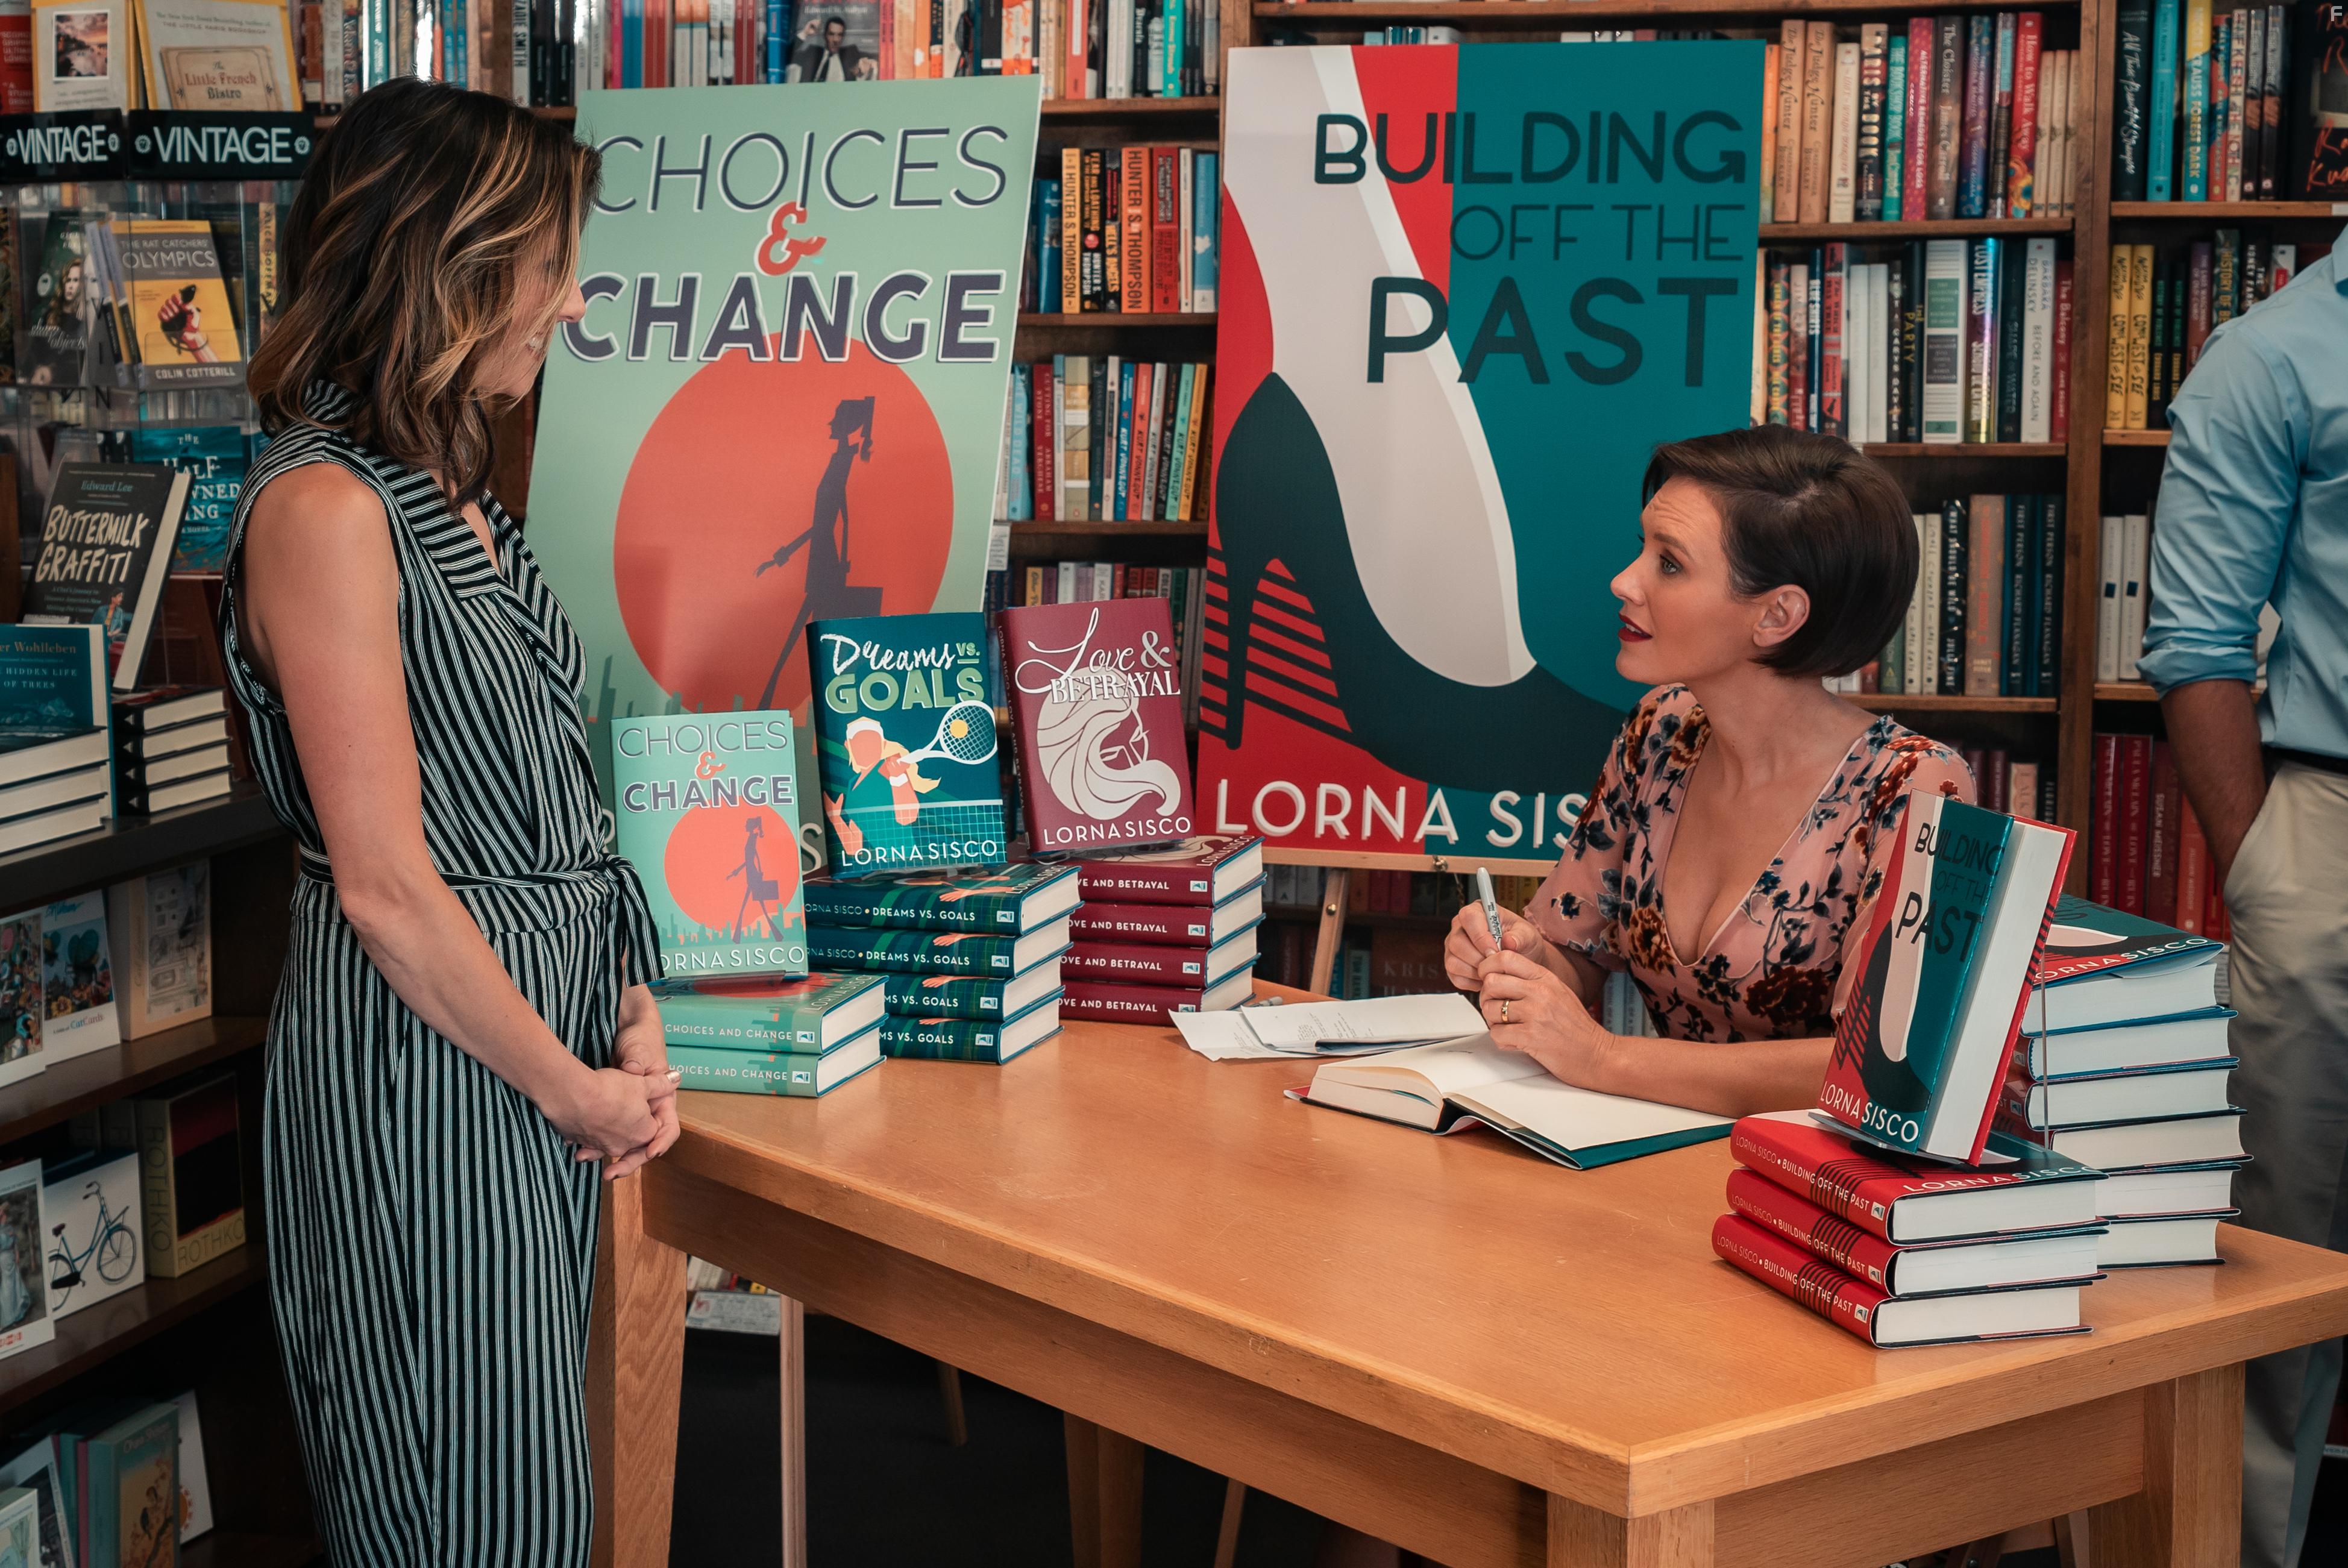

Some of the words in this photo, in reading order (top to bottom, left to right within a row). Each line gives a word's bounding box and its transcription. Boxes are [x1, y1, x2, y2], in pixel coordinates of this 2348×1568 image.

[1943, 25, 1956, 45] The
[2026, 34, 2038, 61] How
[1941, 49, 1956, 93] Cloister
[2025, 66, 2036, 80] to
[2191, 53, 2205, 97] KRAUSS
[2023, 83, 2035, 115] Walk
[2020, 118, 2033, 151] Away
[2189, 101, 2203, 143] FOREST
[16, 125, 108, 164] VINTAGE
[153, 126, 293, 163] VINTAGE
[1314, 110, 1747, 186] BUILDING
[2188, 145, 2200, 178] DARK
[594, 124, 1009, 215] CHOICES
[1128, 150, 1143, 207] HUNTER
[1065, 173, 1076, 219] HUNTER
[753, 200, 827, 277] &
[1450, 204, 1594, 262] OFF
[1610, 204, 1747, 262] THE
[122, 250, 216, 269] OLYMPICS
[1065, 235, 1076, 297] THOMPSON
[1128, 231, 1143, 309] THOMPSON
[2219, 251, 2232, 291] HISTORY
[2026, 257, 2038, 313] DELINSKY
[2040, 260, 2051, 311] BARBARA
[562, 269, 1007, 363] CHANGE
[1366, 276, 1739, 388] PAST
[1904, 312, 1915, 363] PARTY
[2032, 325, 2042, 360] BEFORE
[2031, 365, 2041, 386] AND
[2030, 389, 2040, 421] AGAIN
[43, 504, 149, 548] BUTTERMILK
[35, 542, 132, 585] GRAFFITI
[14, 642, 77, 654] Wohlleben
[820, 633, 956, 675] Dreams
[956, 641, 981, 657] VS.
[1015, 607, 1135, 694] Love
[1140, 630, 1172, 670] &
[825, 667, 985, 713] GOALS
[1050, 670, 1181, 704] BETRAYAL
[618, 721, 788, 758] CHOICES
[694, 751, 727, 780] &
[623, 775, 794, 814] CHANGE
[1044, 823, 1121, 845] LORNA
[1125, 816, 1191, 839] SISCO
[1216, 779, 1458, 844] LORNA
[1486, 789, 1590, 850] SIS
[841, 844, 928, 868] LORNA
[928, 839, 998, 861] SISCO
[1915, 822, 2007, 877] BUILDING
[1093, 879, 1114, 888] AND
[1118, 880, 1169, 890] BETRAYAL
[1933, 869, 1960, 895] OFF
[805, 904, 831, 913] ORNA
[834, 905, 862, 915] SISCO
[873, 908, 915, 918] DREAMS
[919, 909, 935, 919] VS.
[939, 911, 975, 921] GOALS
[1069, 920, 1087, 928] OVE
[1091, 920, 1112, 929] AND
[1116, 922, 1167, 933] BETRAYAL
[1895, 891, 1983, 964] PAST
[661, 951, 724, 971] ORNA
[730, 946, 805, 967] SISCO
[827, 949, 855, 959] SISCO
[866, 951, 909, 962] DREAMS
[913, 954, 930, 964] VS.
[934, 955, 970, 965] GOALS
[1060, 956, 1081, 965] OVE
[1085, 958, 1106, 967] AND
[1111, 959, 1162, 971] BETRAYAL
[2033, 956, 2121, 980] ORNA
[2121, 938, 2208, 961] SISCO
[902, 996, 918, 1005] VS.
[921, 996, 959, 1008] GOALS
[1058, 998, 1076, 1007] OVE
[1081, 1000, 1102, 1009] AND
[1106, 1001, 1158, 1012] BETRAYAL
[665, 1024, 714, 1036] CHOICES
[719, 1027, 741, 1037] AND
[746, 1030, 792, 1041] CHANGE
[897, 1033, 914, 1042] VS.
[917, 1033, 954, 1044] GOALS
[669, 1064, 710, 1075] HOICES
[715, 1068, 737, 1077] AND
[742, 1070, 788, 1081] CHANGE
[1819, 1080, 1860, 1123] LORNA
[1862, 1102, 1920, 1144] SISCO
[1735, 1134, 1756, 1158] LORNA
[1756, 1146, 1777, 1164] SISCO
[1781, 1158, 1816, 1185] BUILDING
[1816, 1177, 1833, 1193] OFF
[1834, 1184, 1849, 1202] THE
[1850, 1190, 1871, 1211] PAST
[1903, 1174, 2014, 1192] LORNA
[2013, 1165, 2100, 1183] SISCO
[1731, 1194, 1752, 1217] LORNA
[1752, 1206, 1773, 1225] SISCO
[1777, 1217, 1812, 1246] BUILDING
[1812, 1236, 1828, 1254] OFF
[1830, 1244, 1845, 1262] THE
[1847, 1252, 1866, 1275] PAST
[1716, 1234, 1738, 1257] LORNA
[1738, 1245, 1759, 1264] SISCO
[1763, 1258, 1798, 1287] BUILDING
[1799, 1276, 1815, 1294] OFF
[1816, 1284, 1832, 1302] THE
[1833, 1291, 1853, 1314] PAST
